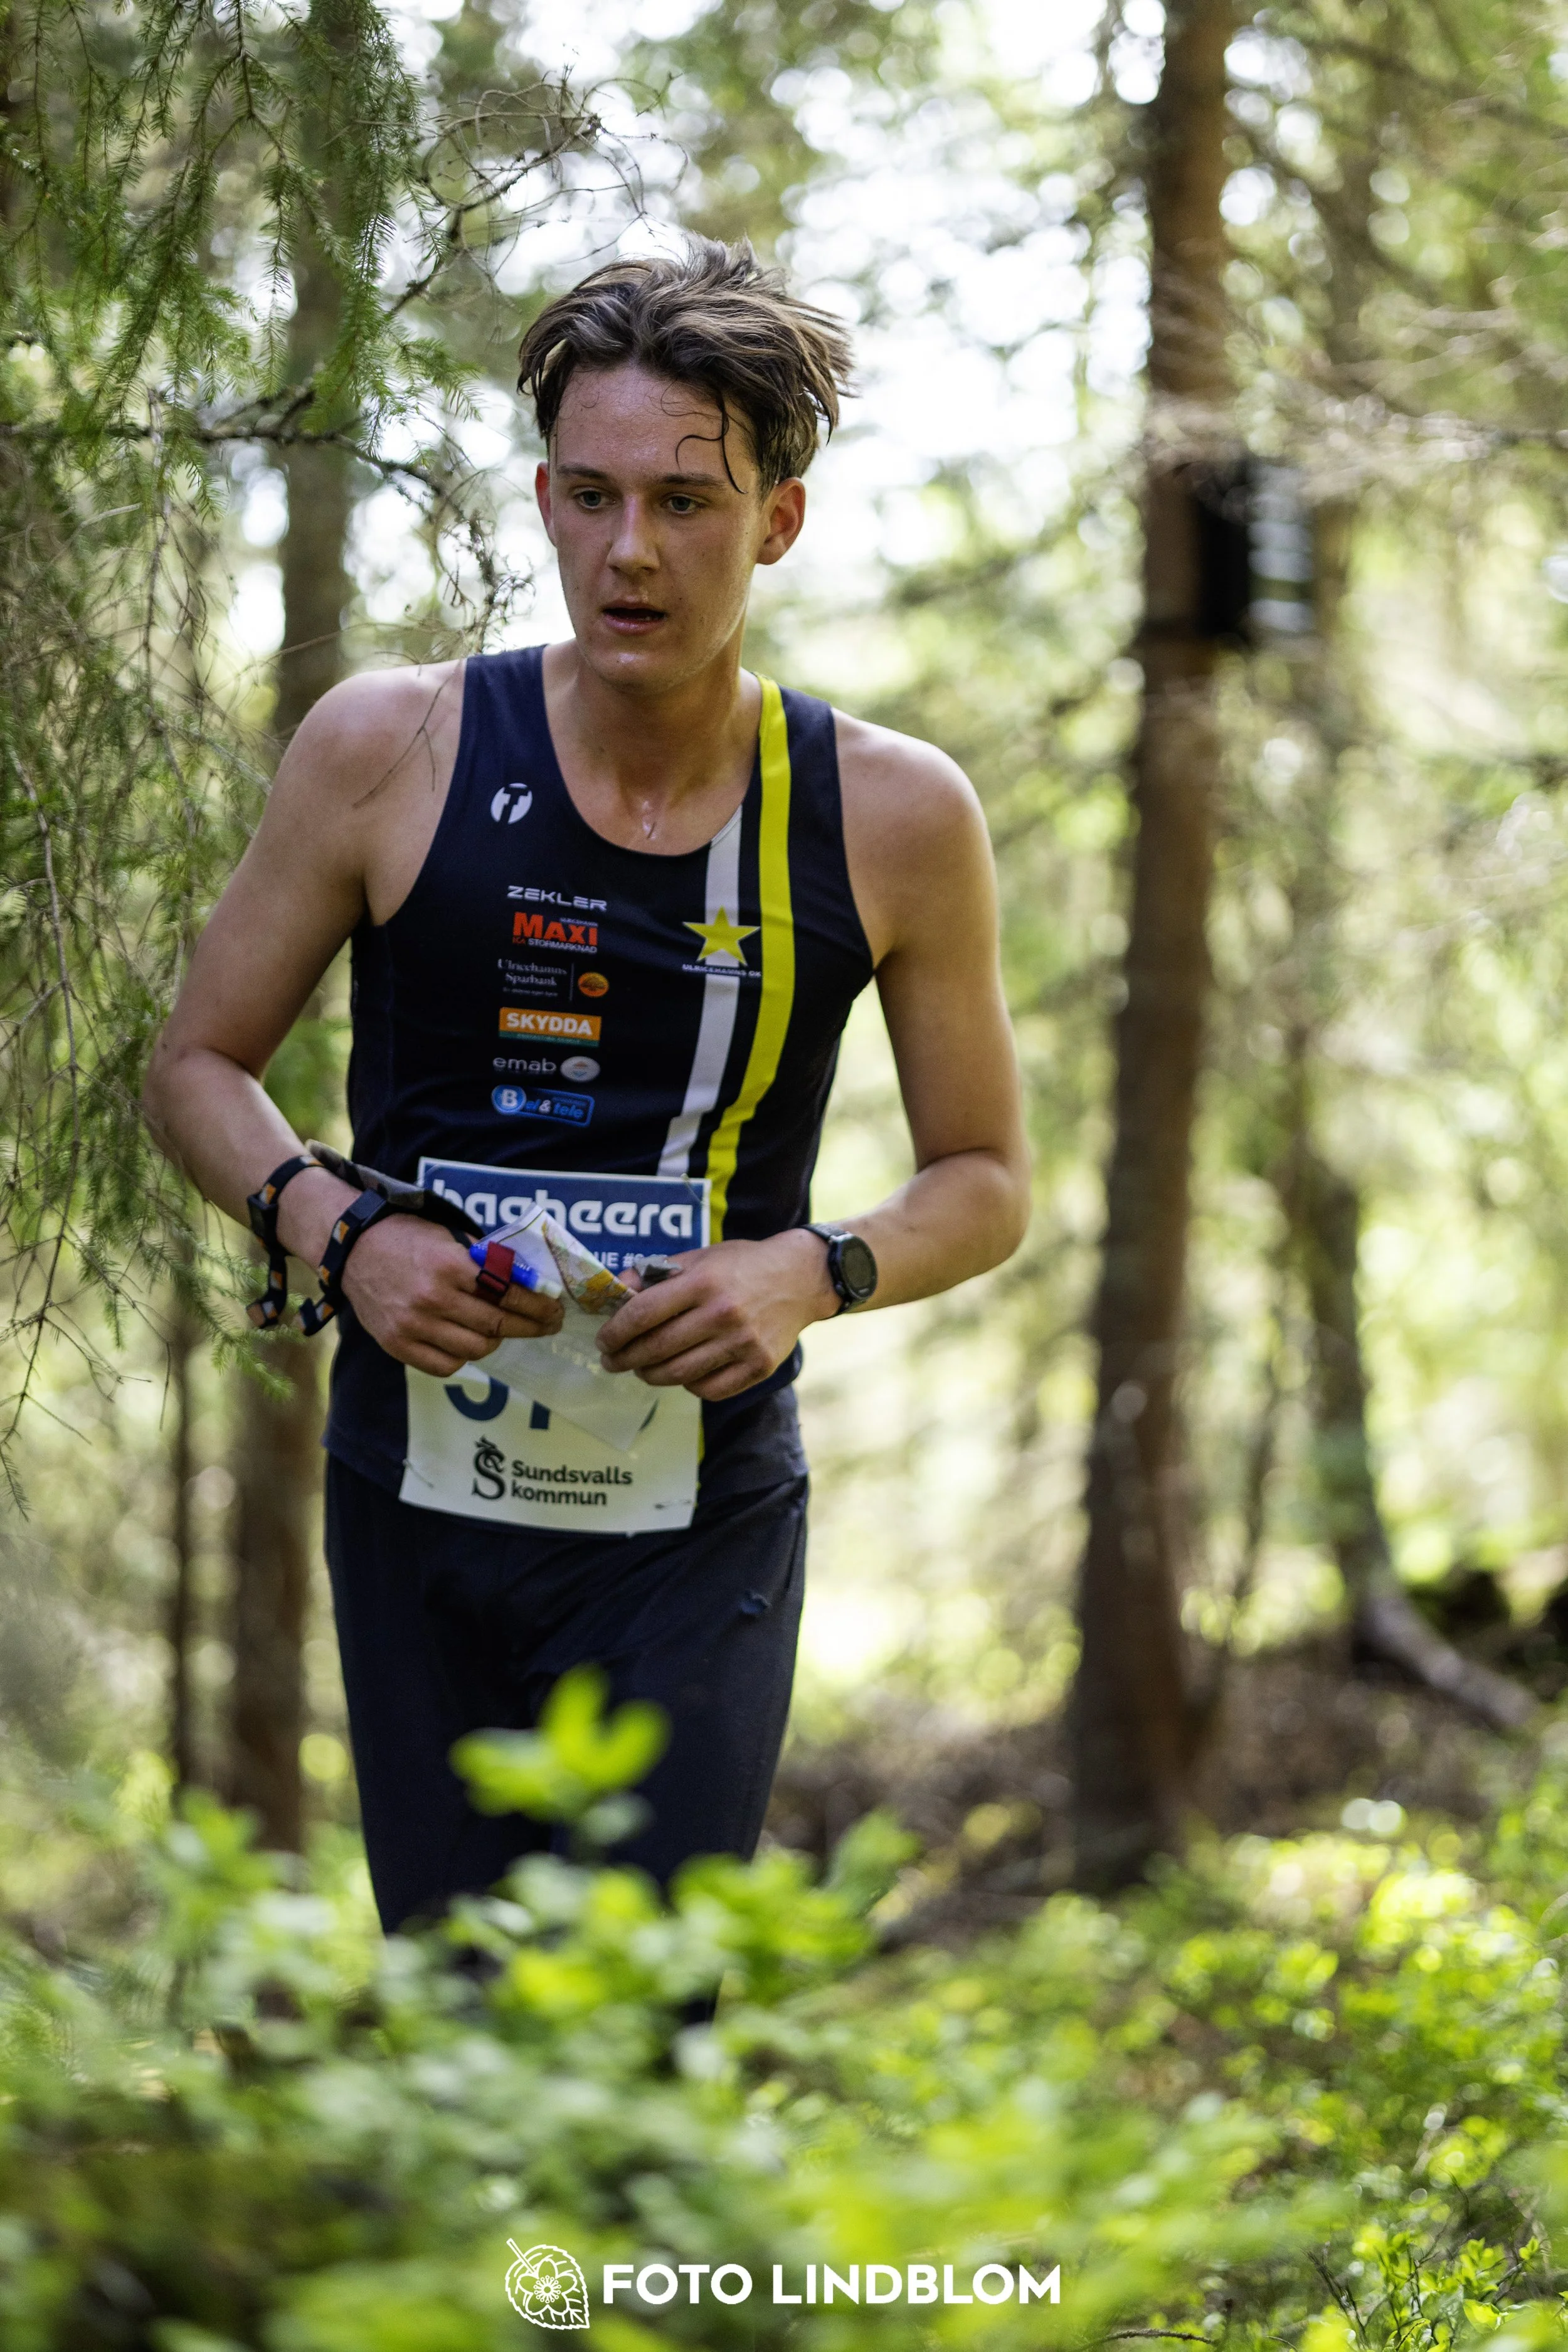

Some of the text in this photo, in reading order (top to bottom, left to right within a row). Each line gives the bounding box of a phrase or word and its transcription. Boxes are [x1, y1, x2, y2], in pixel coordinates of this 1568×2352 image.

[507, 885, 607, 911] ZEKLER
[512, 911, 598, 946] MAXI
[506, 1012, 593, 1036] SKYDDA
[492, 1057, 557, 1072] emab
[502, 1088, 518, 1108] B
[511, 1459, 632, 1485] Sundsvalls
[511, 1479, 607, 1506] kommun
